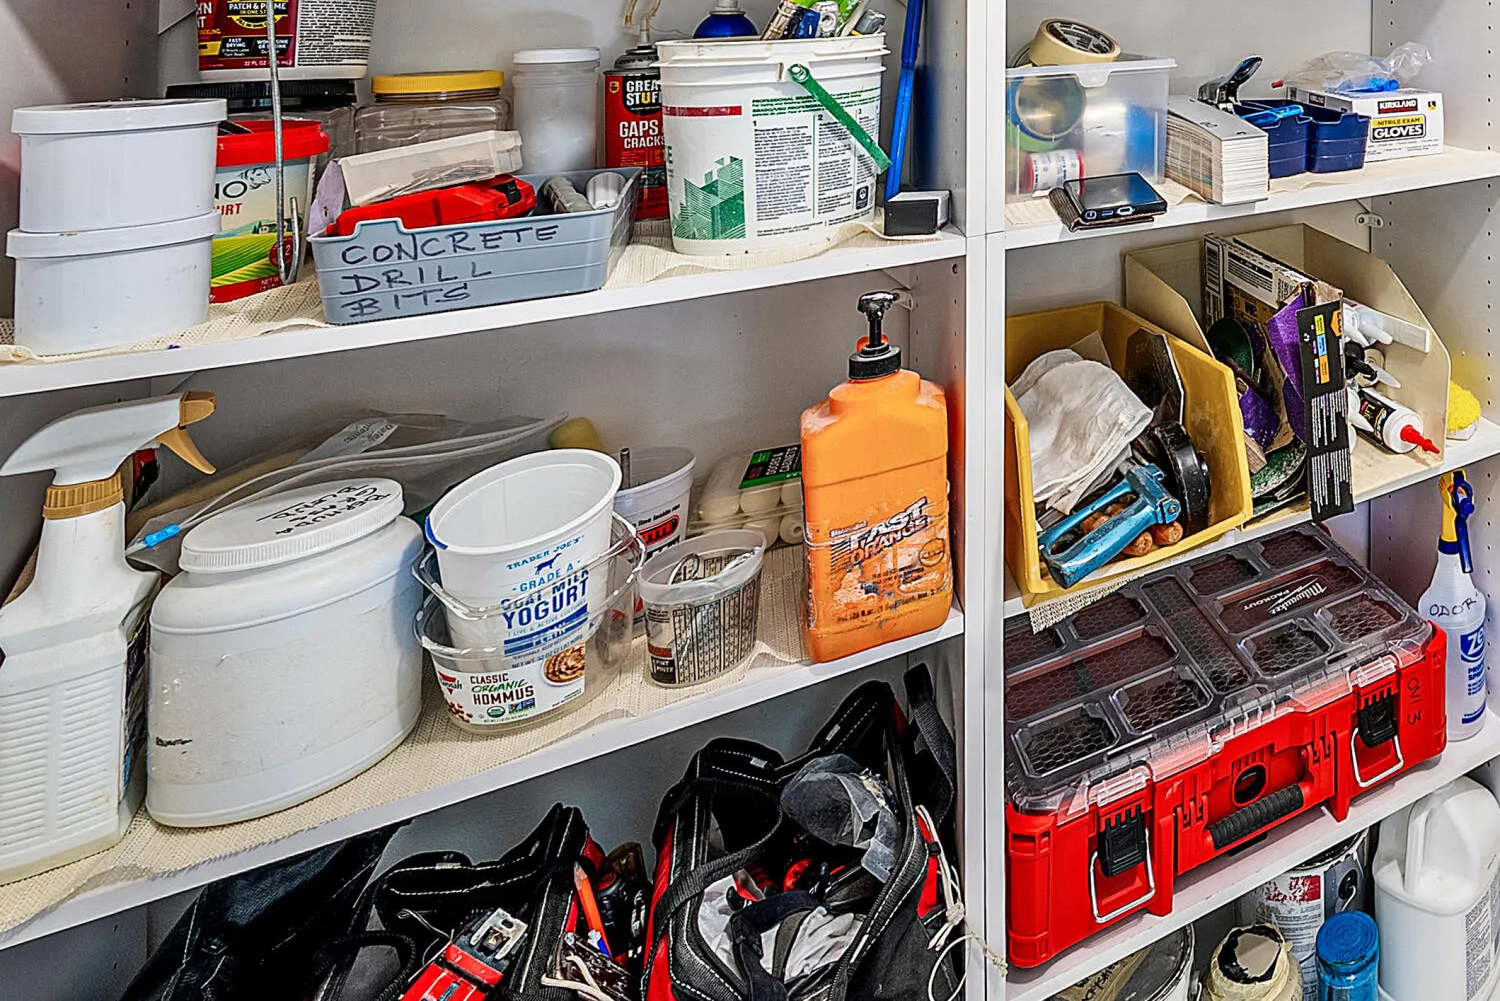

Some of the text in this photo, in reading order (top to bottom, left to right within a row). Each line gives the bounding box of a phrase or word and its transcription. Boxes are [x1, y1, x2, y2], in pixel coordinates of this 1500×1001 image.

[228, 3, 252, 11] PATCH
[260, 2, 287, 10] PME
[626, 79, 661, 93] GREA
[626, 92, 661, 106] STUF
[1379, 100, 1417, 110] KIRKLAND
[620, 119, 659, 138] GAPS
[1373, 124, 1423, 139] GLOVES
[1377, 117, 1421, 126] NITRILE EXAM
[341, 224, 559, 266] CONCRETE
[339, 261, 492, 296] DRILL
[340, 283, 470, 318] BITS
[850, 496, 929, 549] FAST
[850, 515, 929, 562] ORANGE
[506, 550, 550, 570] TRADER
[519, 563, 574, 593] GRADE A
[501, 577, 589, 630] YOGURT
[1243, 589, 1290, 611] PACKOUT
[1269, 582, 1328, 615] Milwaukee
[1429, 597, 1477, 618] ODOR
[469, 672, 509, 685] CLASSIC
[471, 679, 528, 693] ORGANIC
[472, 685, 534, 705] HOMMUS
